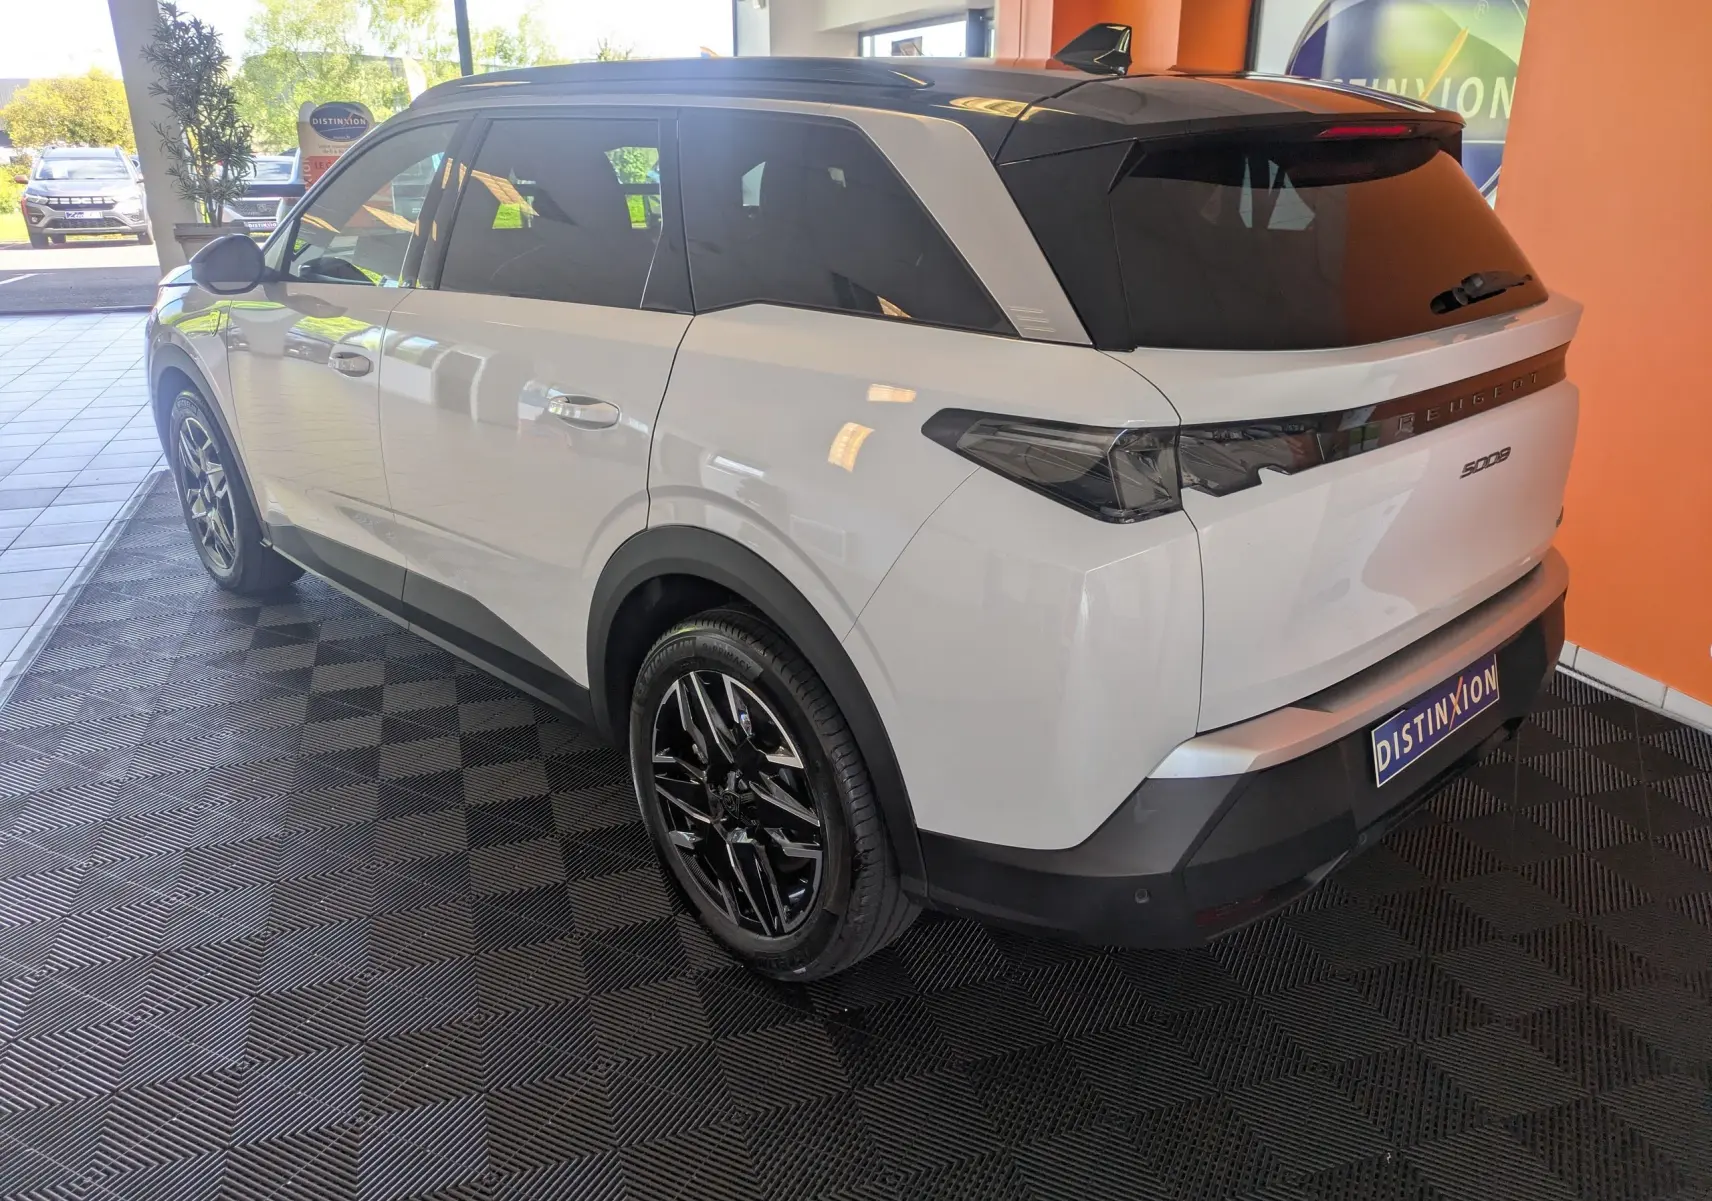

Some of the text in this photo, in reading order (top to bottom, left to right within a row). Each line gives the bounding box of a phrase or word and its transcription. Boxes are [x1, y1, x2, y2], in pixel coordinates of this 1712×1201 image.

[312, 117, 367, 126] DISTINXION
[1398, 371, 1538, 433] PEUGEOT
[1376, 664, 1498, 773] DISTINXION
